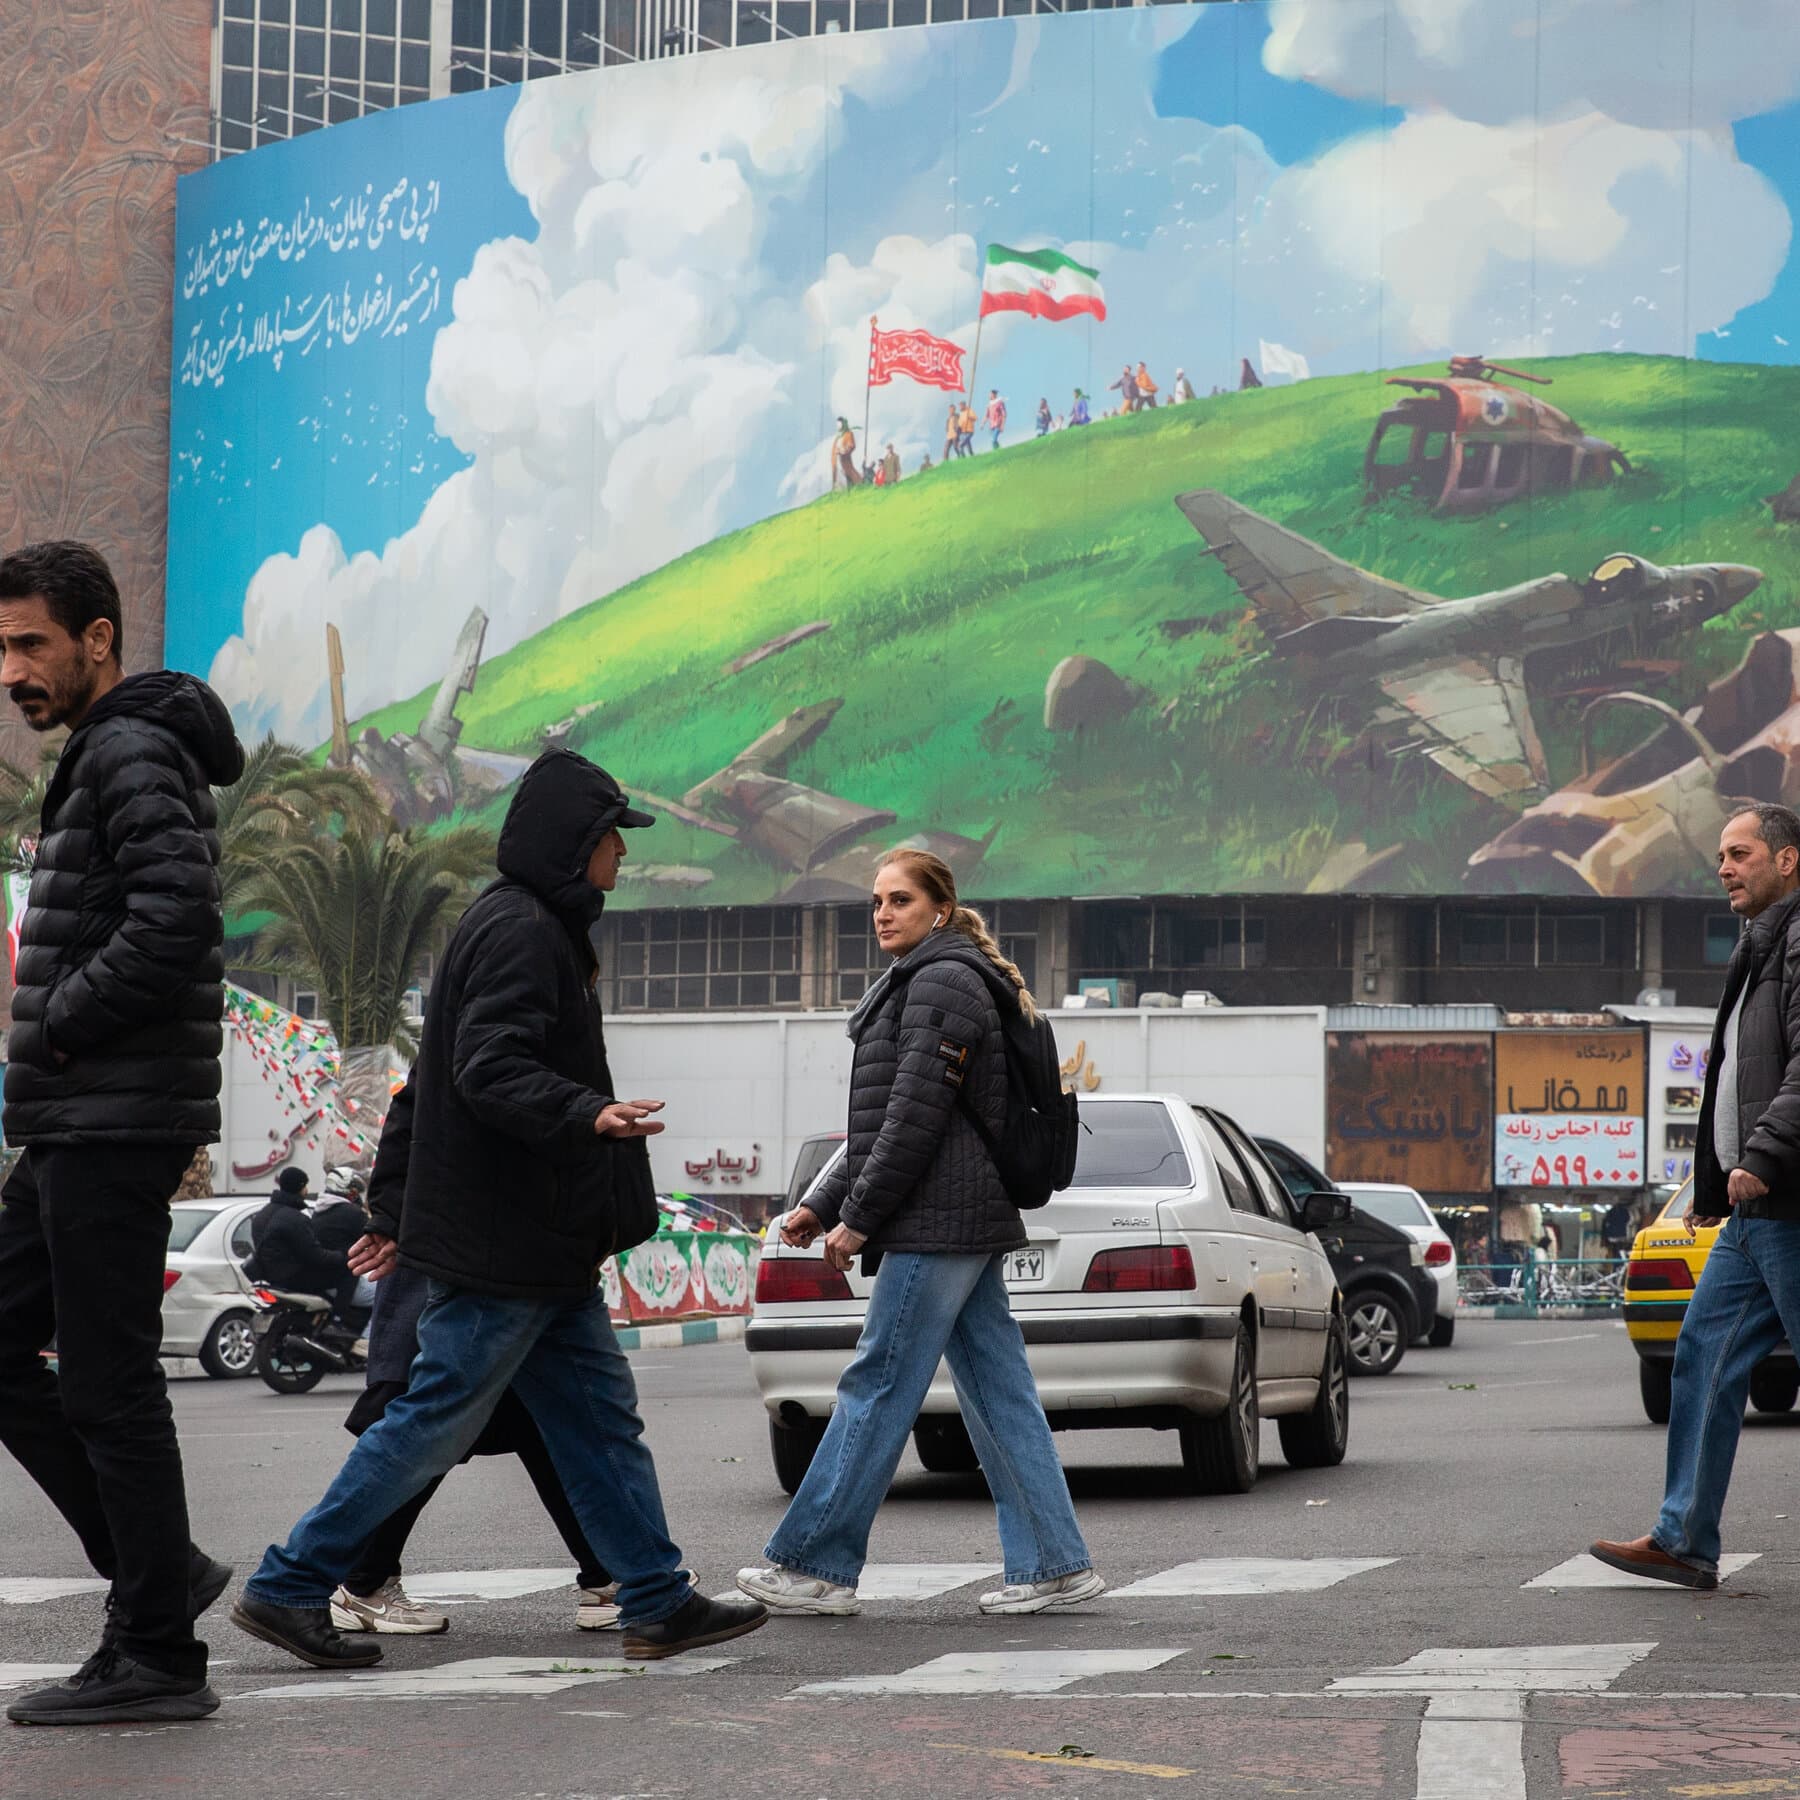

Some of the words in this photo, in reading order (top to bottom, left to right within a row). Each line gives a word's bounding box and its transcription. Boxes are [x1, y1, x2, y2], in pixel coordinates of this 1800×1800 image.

[367, 177, 408, 251] صبحی
[400, 187, 430, 244] پی
[420, 180, 440, 220] از
[278, 205, 316, 262] میان
[308, 217, 325, 249] در
[183, 227, 223, 300] شهیدان
[216, 219, 245, 288] شوق
[380, 274, 430, 338] مسیر
[418, 266, 440, 323] از
[1576, 1044, 1632, 1062] فروشگاه
[1505, 1119, 1542, 1141] زنانه
[1546, 1120, 1599, 1143] اجناس
[1603, 1120, 1634, 1140] کلیه
[684, 1143, 763, 1184] زیبایی
[1531, 1154, 1639, 1186] ۵۹۹۰۰۰
[1112, 1217, 1151, 1227] PARS
[1014, 1257, 1041, 1278] ۴۷
